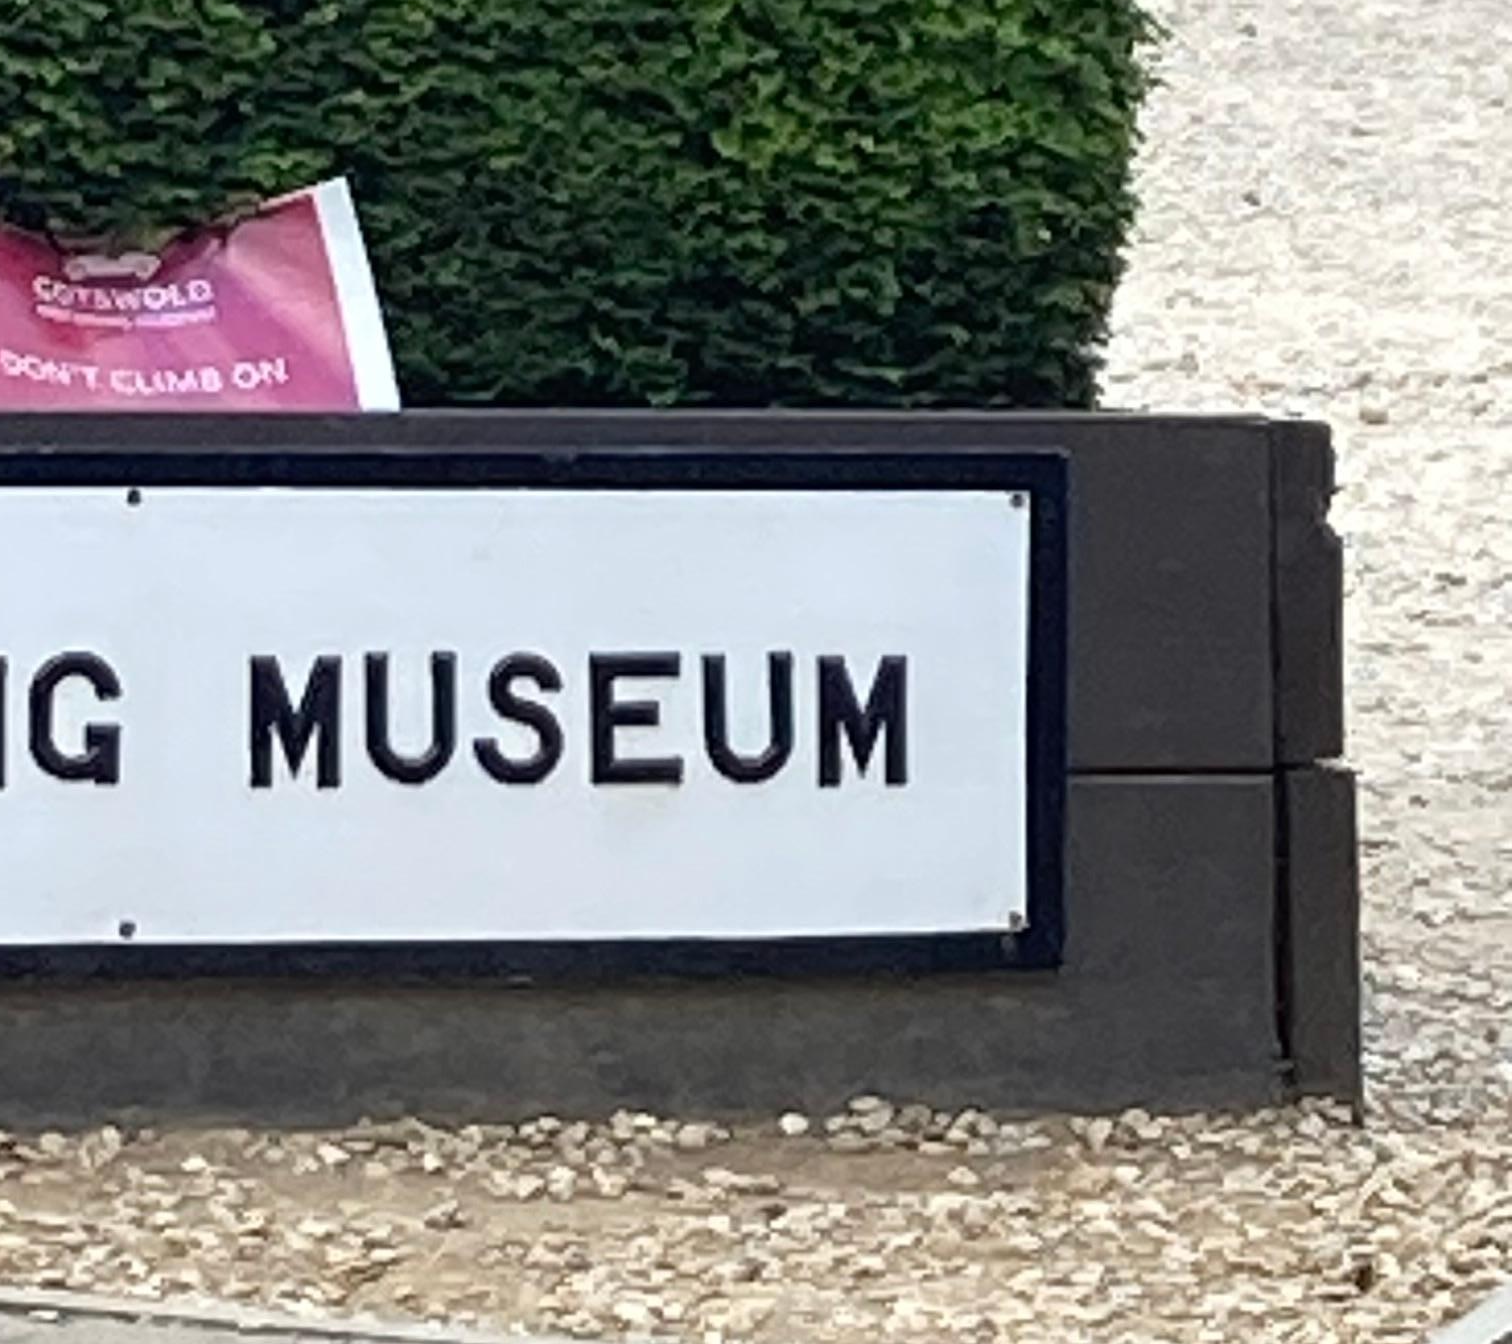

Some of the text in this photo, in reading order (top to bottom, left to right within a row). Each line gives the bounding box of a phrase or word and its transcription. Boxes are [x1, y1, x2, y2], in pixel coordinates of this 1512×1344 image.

[32, 275, 215, 310] COTSWOLD
[110, 367, 222, 395] CLIMB
[231, 358, 289, 390] ON
[250, 651, 907, 790] MUSEUM
